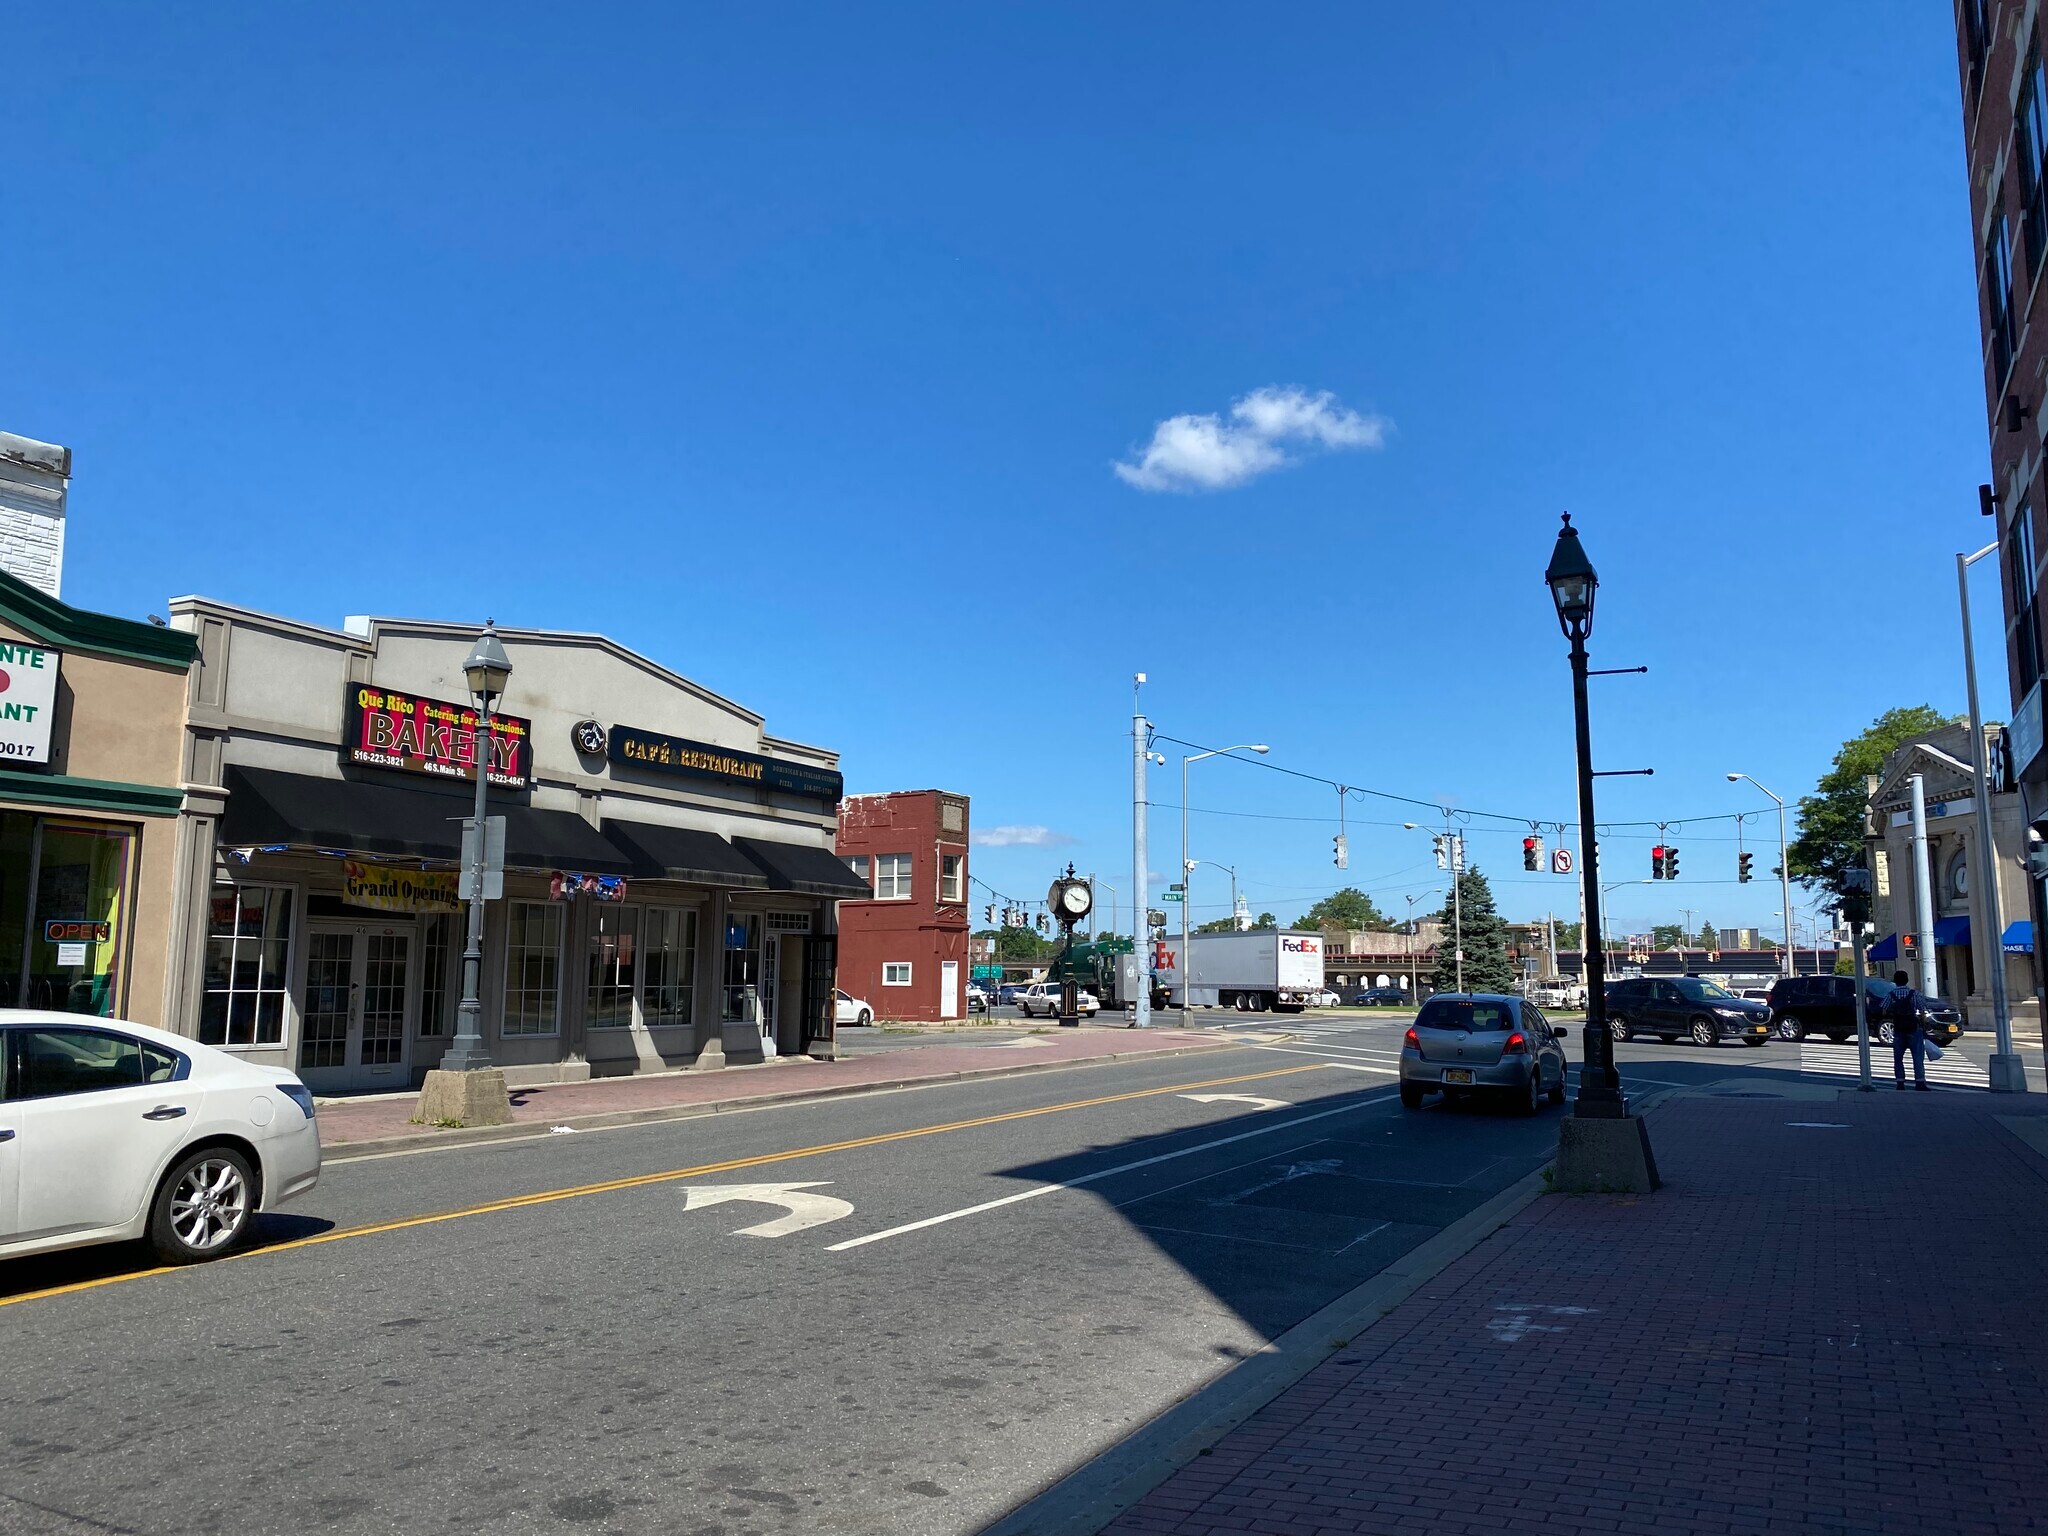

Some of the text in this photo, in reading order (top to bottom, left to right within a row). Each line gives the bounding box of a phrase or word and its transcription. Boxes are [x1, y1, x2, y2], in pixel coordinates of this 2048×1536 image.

[0, 702, 38, 723] NT
[358, 689, 414, 714] Que Rico
[423, 706, 459, 725] Catering
[460, 713, 473, 726] for
[354, 750, 404, 767] 516-223-3821
[456, 767, 466, 777] St.
[486, 772, 525, 787] 16-223-4847
[623, 738, 764, 780] CAFÉ & RESTAURANT
[779, 779, 793, 788] PIZZA
[347, 878, 459, 910] Grand Opening
[49, 923, 107, 939] OPEN
[1149, 942, 1176, 969] dEx
[1282, 938, 1318, 953] FedEx
